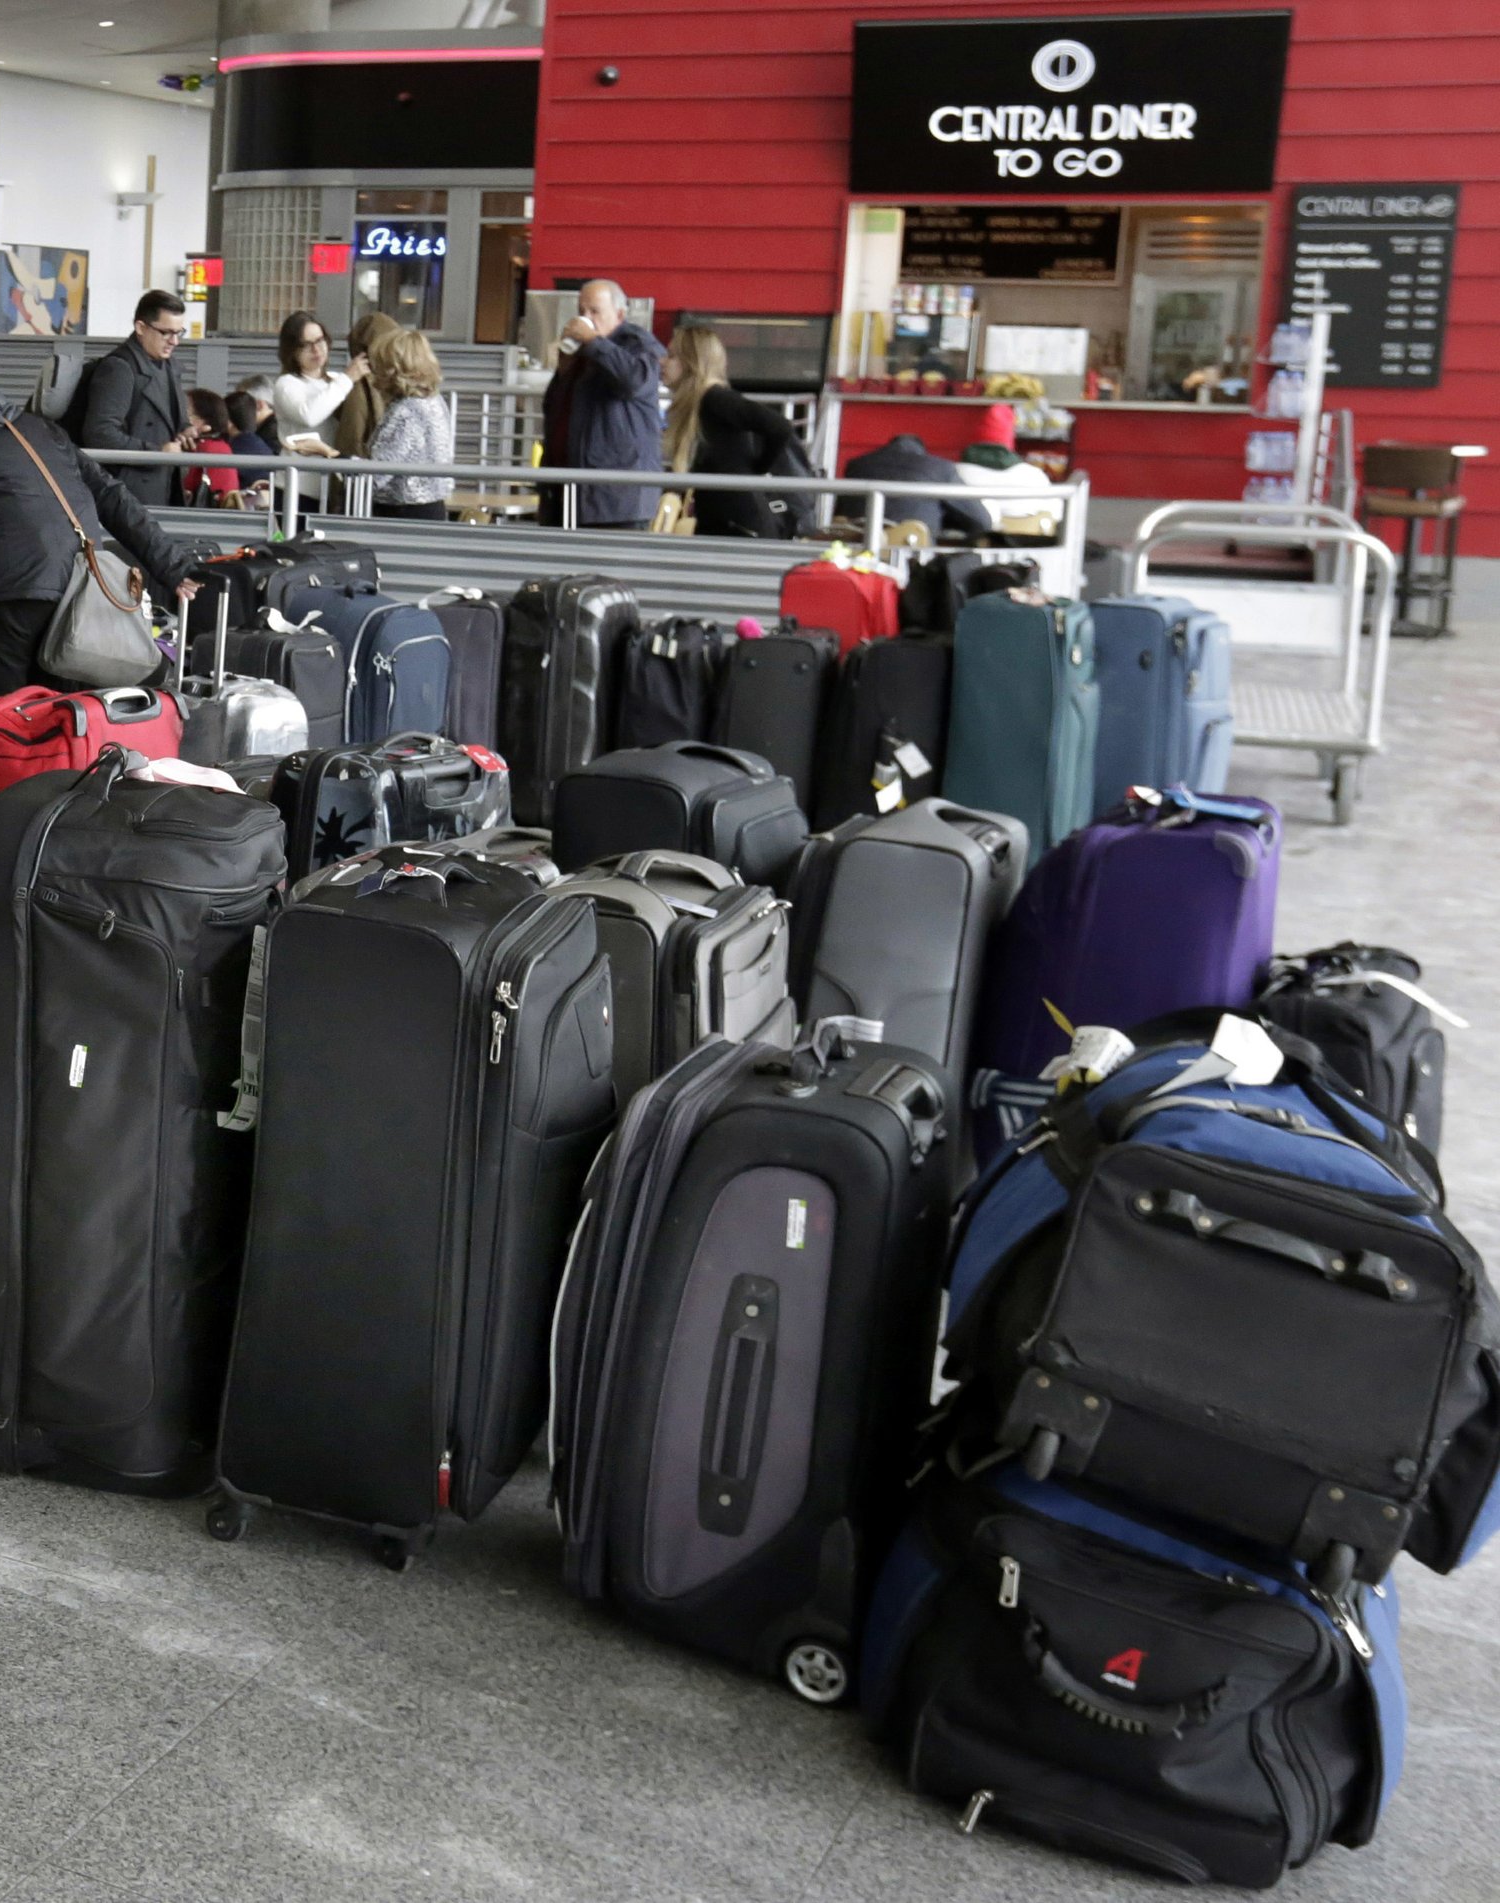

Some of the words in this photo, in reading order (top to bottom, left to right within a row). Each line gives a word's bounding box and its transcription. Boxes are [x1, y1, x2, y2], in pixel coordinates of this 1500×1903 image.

[928, 104, 1084, 142] CENTRAL
[1090, 103, 1197, 140] DINER
[993, 148, 1043, 178] TO
[1053, 147, 1124, 178] GO
[1298, 195, 1372, 217] CENTRAL
[1372, 195, 1425, 216] DINER
[360, 227, 446, 256] Fries
